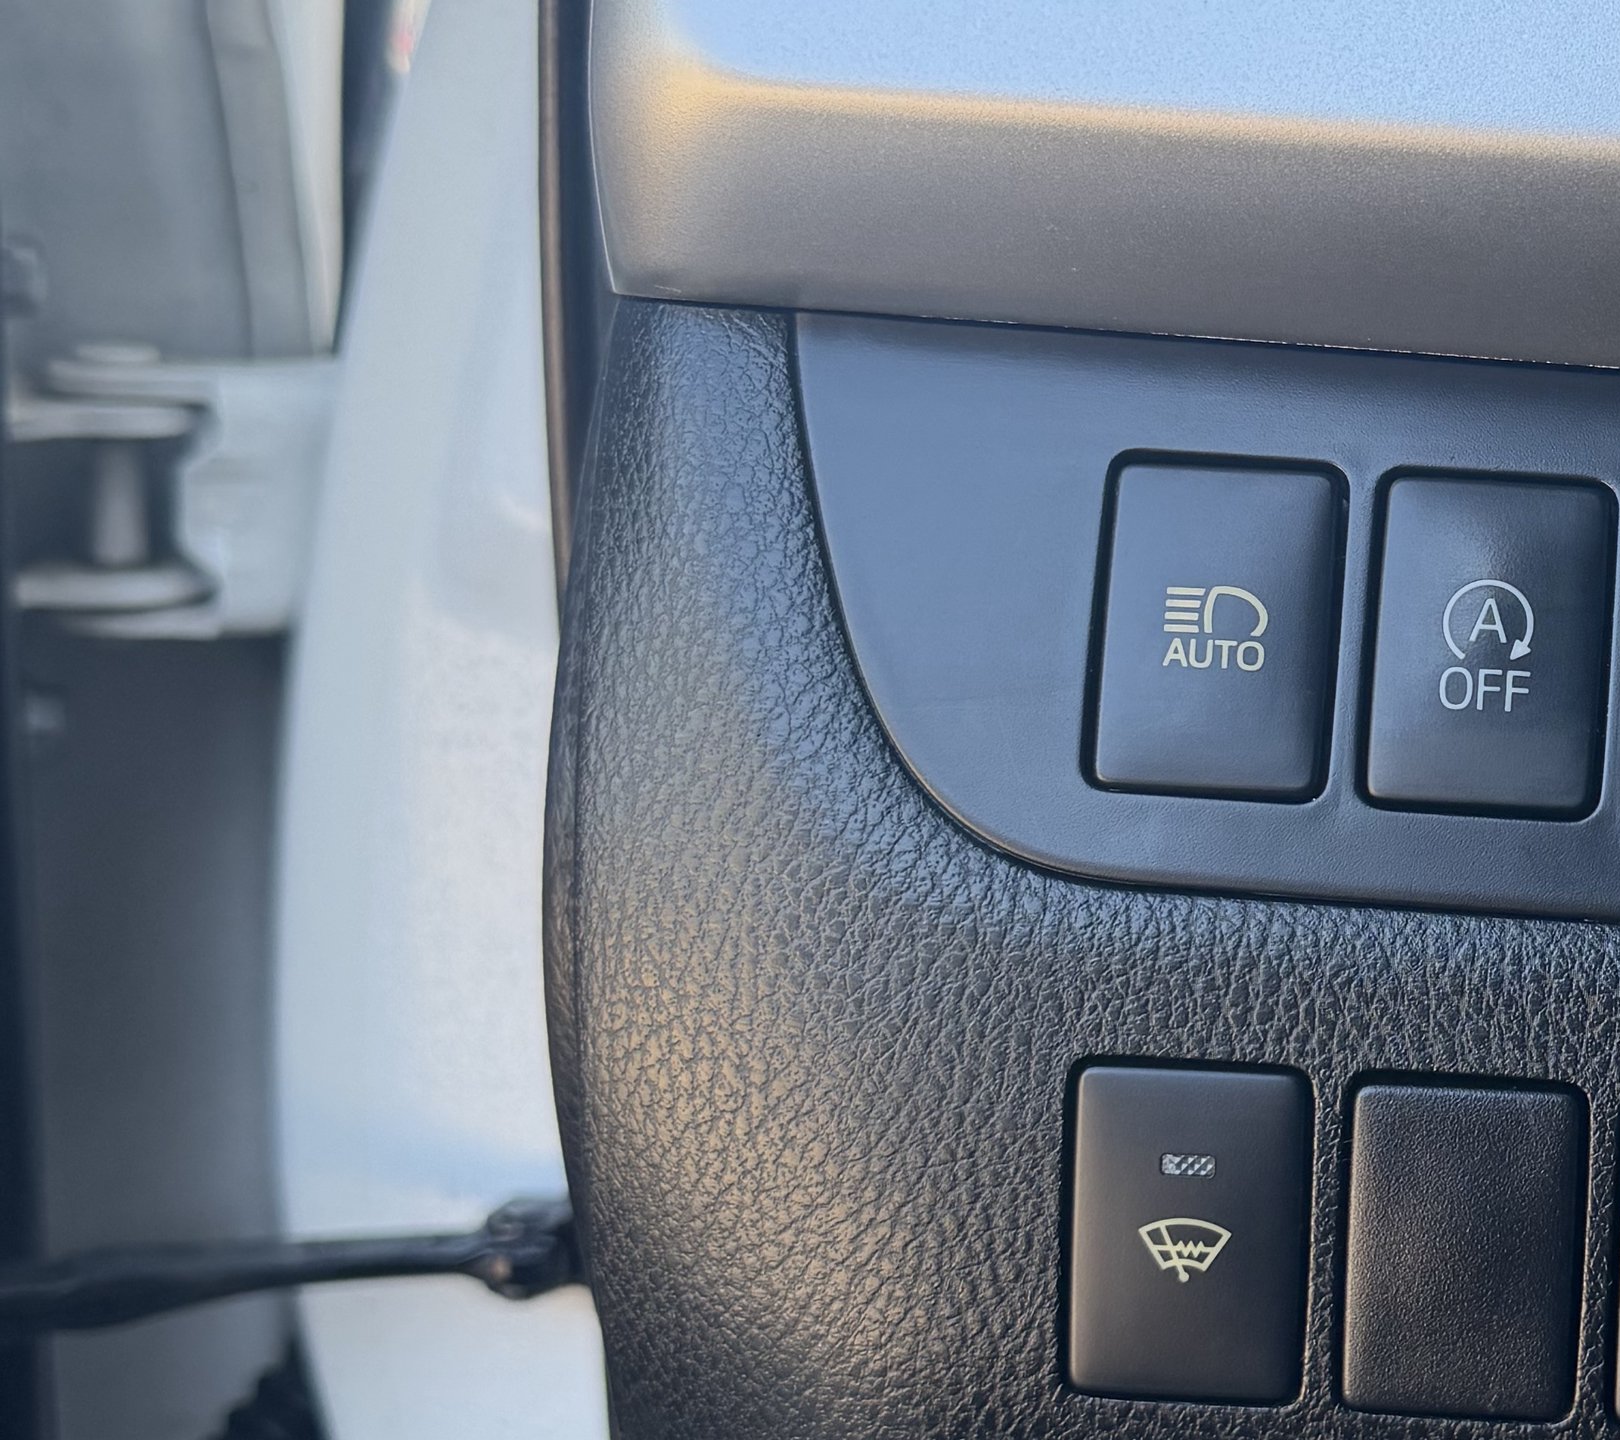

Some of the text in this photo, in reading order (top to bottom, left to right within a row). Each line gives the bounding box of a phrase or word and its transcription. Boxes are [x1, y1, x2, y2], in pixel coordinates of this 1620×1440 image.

[1468, 597, 1508, 644] A
[1162, 637, 1265, 671] AUTO
[1439, 665, 1532, 712] OFF
